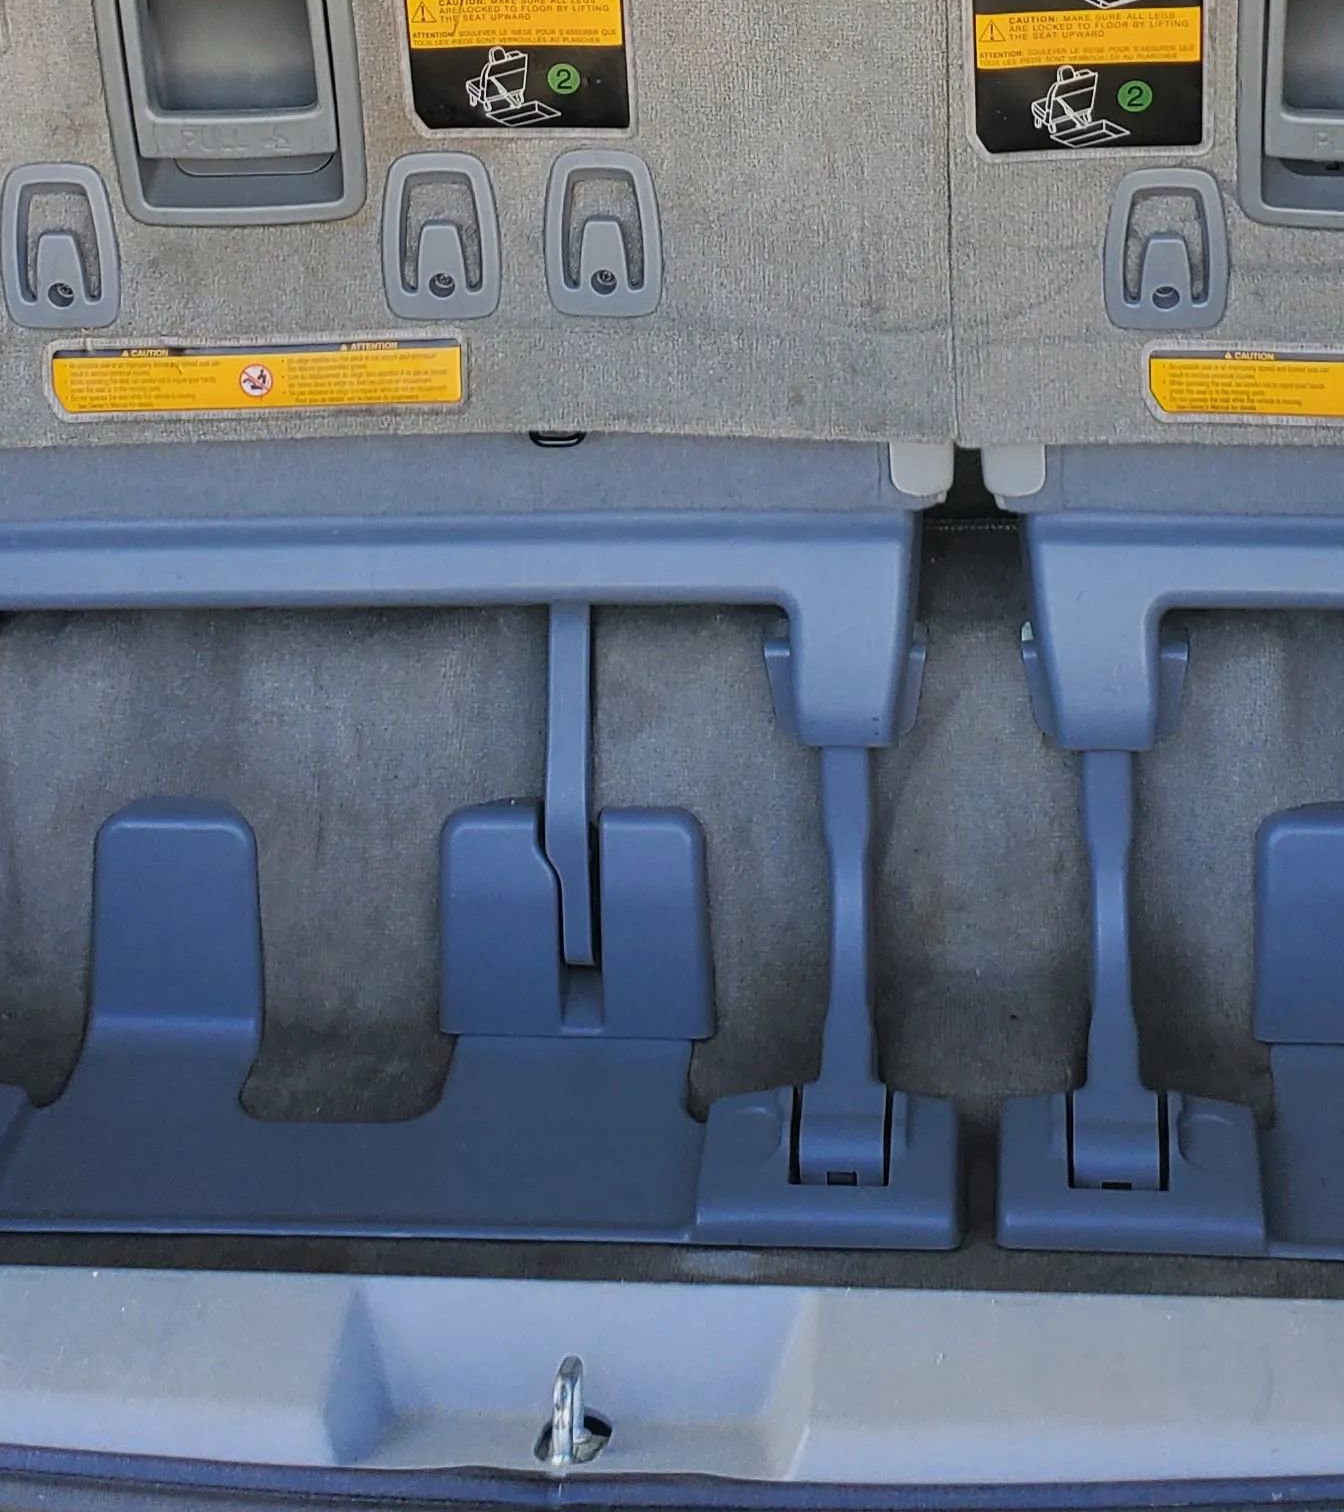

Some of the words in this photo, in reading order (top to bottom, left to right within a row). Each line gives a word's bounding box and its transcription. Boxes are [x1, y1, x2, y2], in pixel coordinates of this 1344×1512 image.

[1009, 16, 1058, 24] CAUTION:
[1032, 23, 1072, 31] LOCKED
[1062, 31, 1104, 39] UPWARD
[556, 69, 572, 89] 2
[1127, 86, 1144, 107] 2
[351, 342, 398, 351] ATTENTION
[1235, 352, 1274, 360] CAUTION
